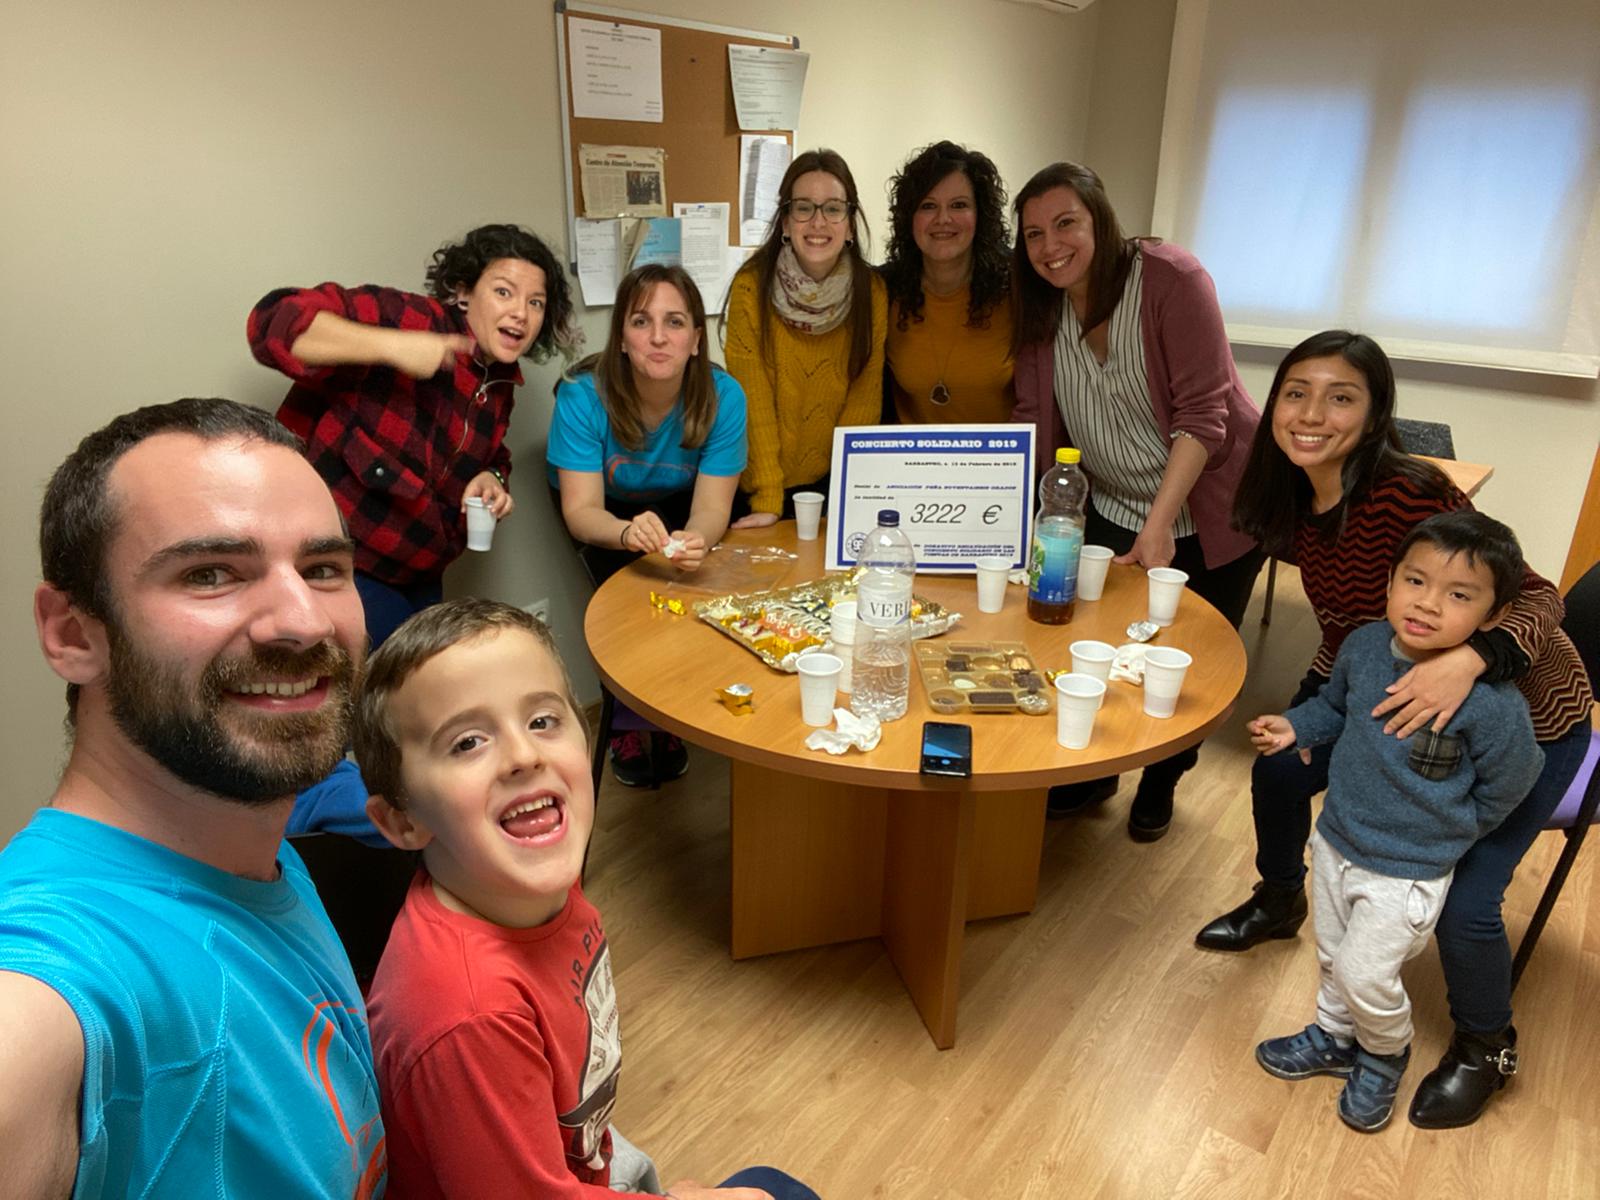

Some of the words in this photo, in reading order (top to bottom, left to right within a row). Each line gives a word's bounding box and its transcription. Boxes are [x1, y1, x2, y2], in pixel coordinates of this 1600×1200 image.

[851, 440, 915, 448] CONCIERTO
[917, 440, 982, 448] SOLIDARIO
[988, 439, 1018, 448] 2019
[909, 503, 967, 524] 3222
[982, 504, 1003, 525] €
